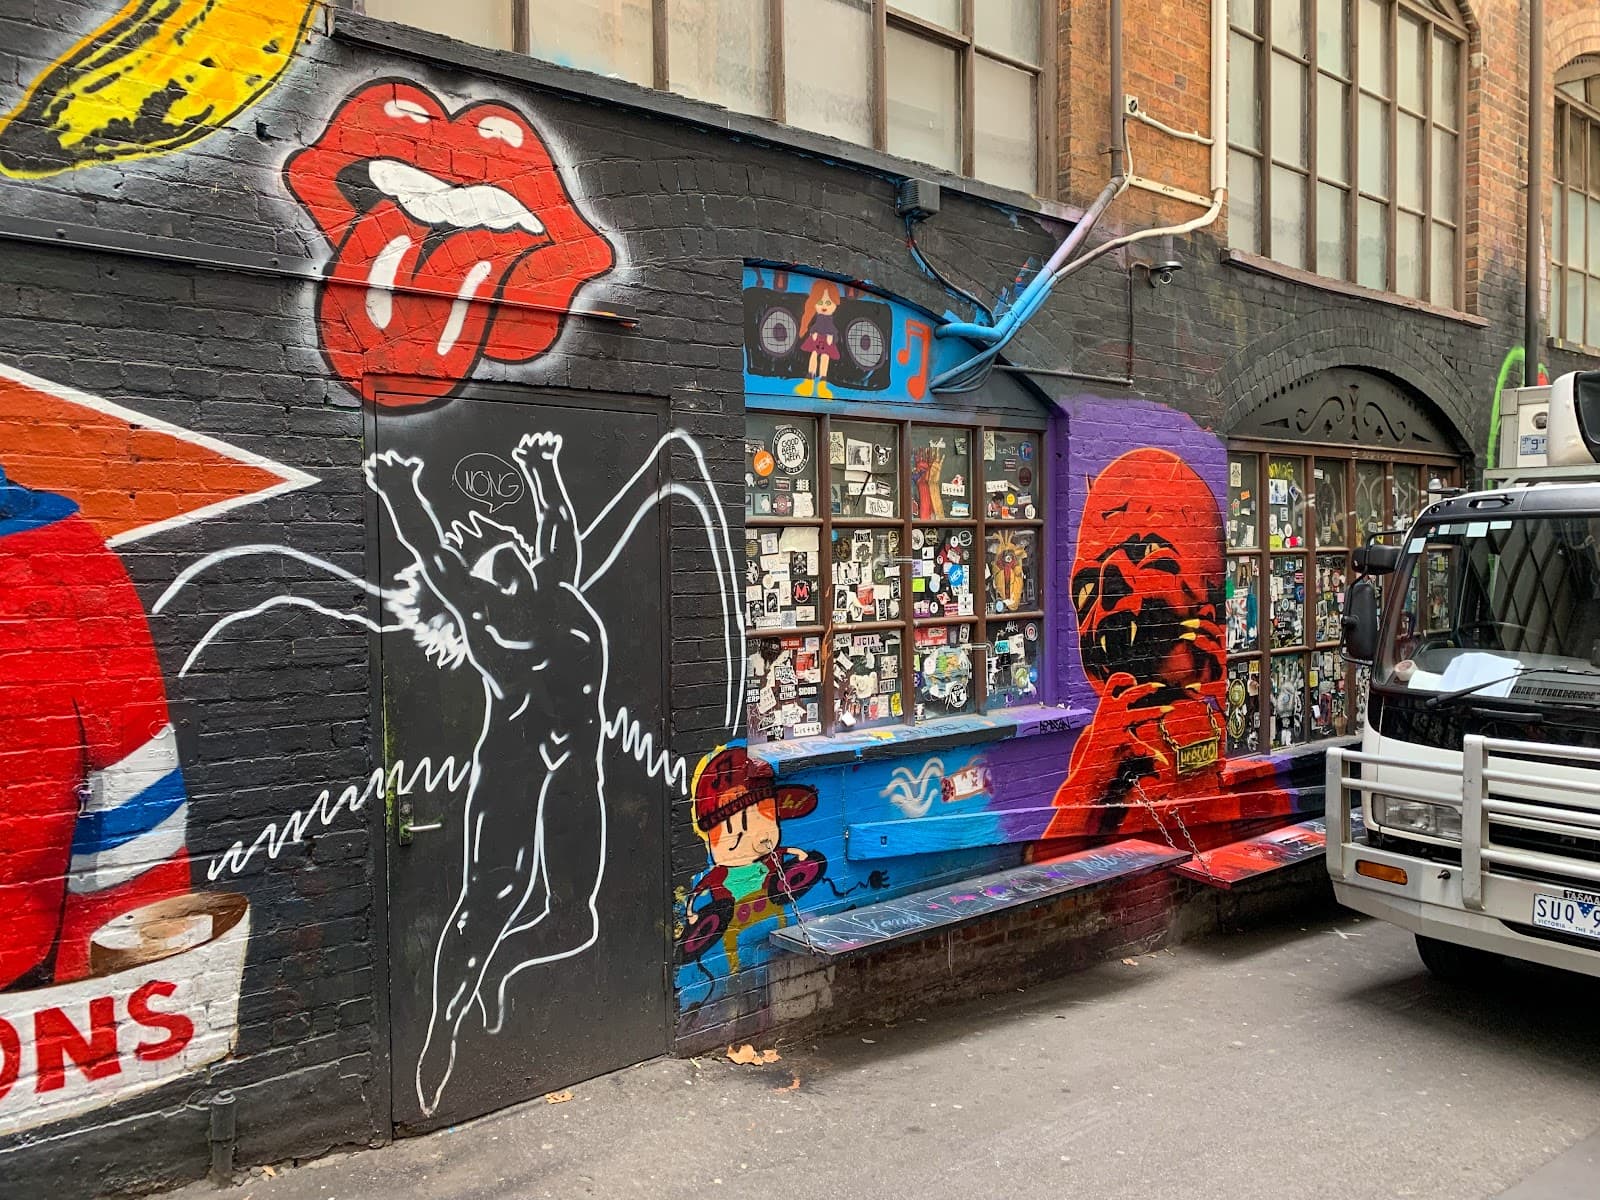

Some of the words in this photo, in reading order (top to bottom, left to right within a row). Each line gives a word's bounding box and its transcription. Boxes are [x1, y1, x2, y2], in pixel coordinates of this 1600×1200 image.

[465, 470, 519, 497] NONG
[1537, 899, 1574, 923] SUQ
[1538, 919, 1566, 928] VICTORIA
